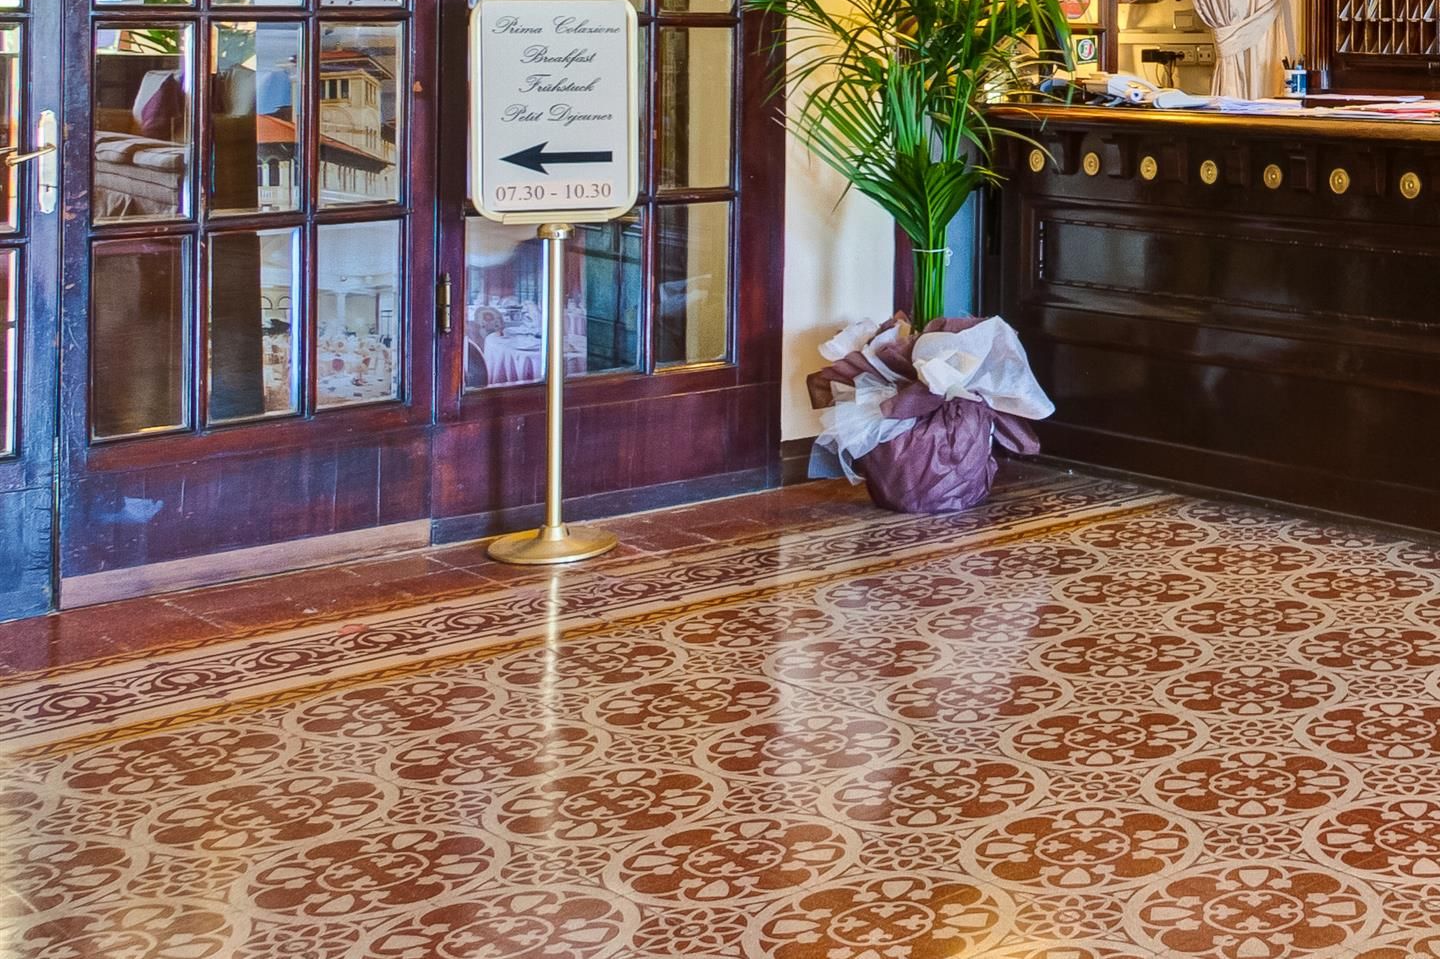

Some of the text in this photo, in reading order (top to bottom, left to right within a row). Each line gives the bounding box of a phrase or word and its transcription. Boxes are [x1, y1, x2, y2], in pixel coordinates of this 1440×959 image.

[491, 15, 621, 35] Prima Colazione
[520, 44, 598, 69] Breakfast
[500, 103, 544, 123] Petit
[495, 185, 545, 202] 07.30
[565, 182, 612, 200] 10.30
